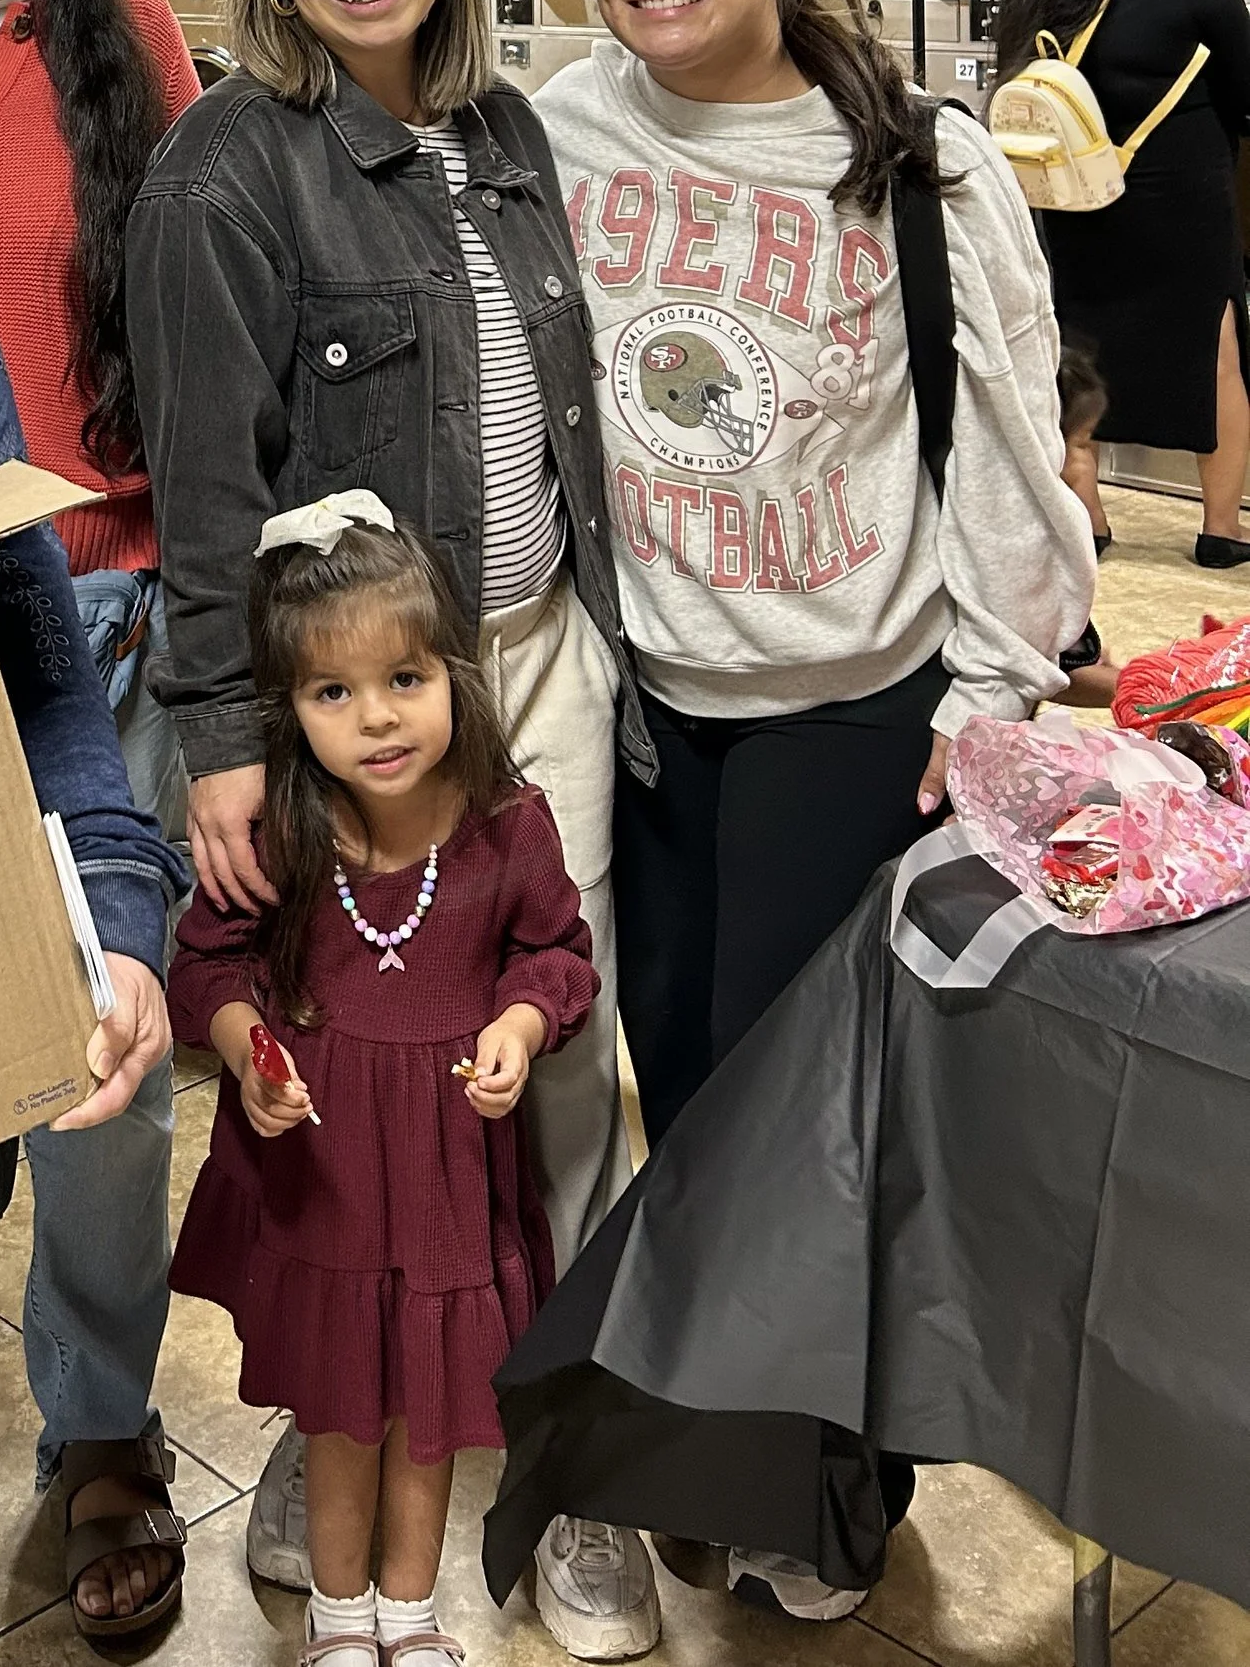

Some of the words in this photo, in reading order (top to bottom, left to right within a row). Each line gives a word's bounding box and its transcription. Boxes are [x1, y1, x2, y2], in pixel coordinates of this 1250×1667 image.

[959, 65, 974, 76] 27
[619, 327, 644, 399] NATIONAL
[649, 308, 722, 327] FOOTBALL
[730, 326, 772, 431] CONFERENCE
[810, 337, 880, 411] 81
[650, 437, 740, 469] CHAMPIONS
[603, 461, 885, 595] OTBALL
